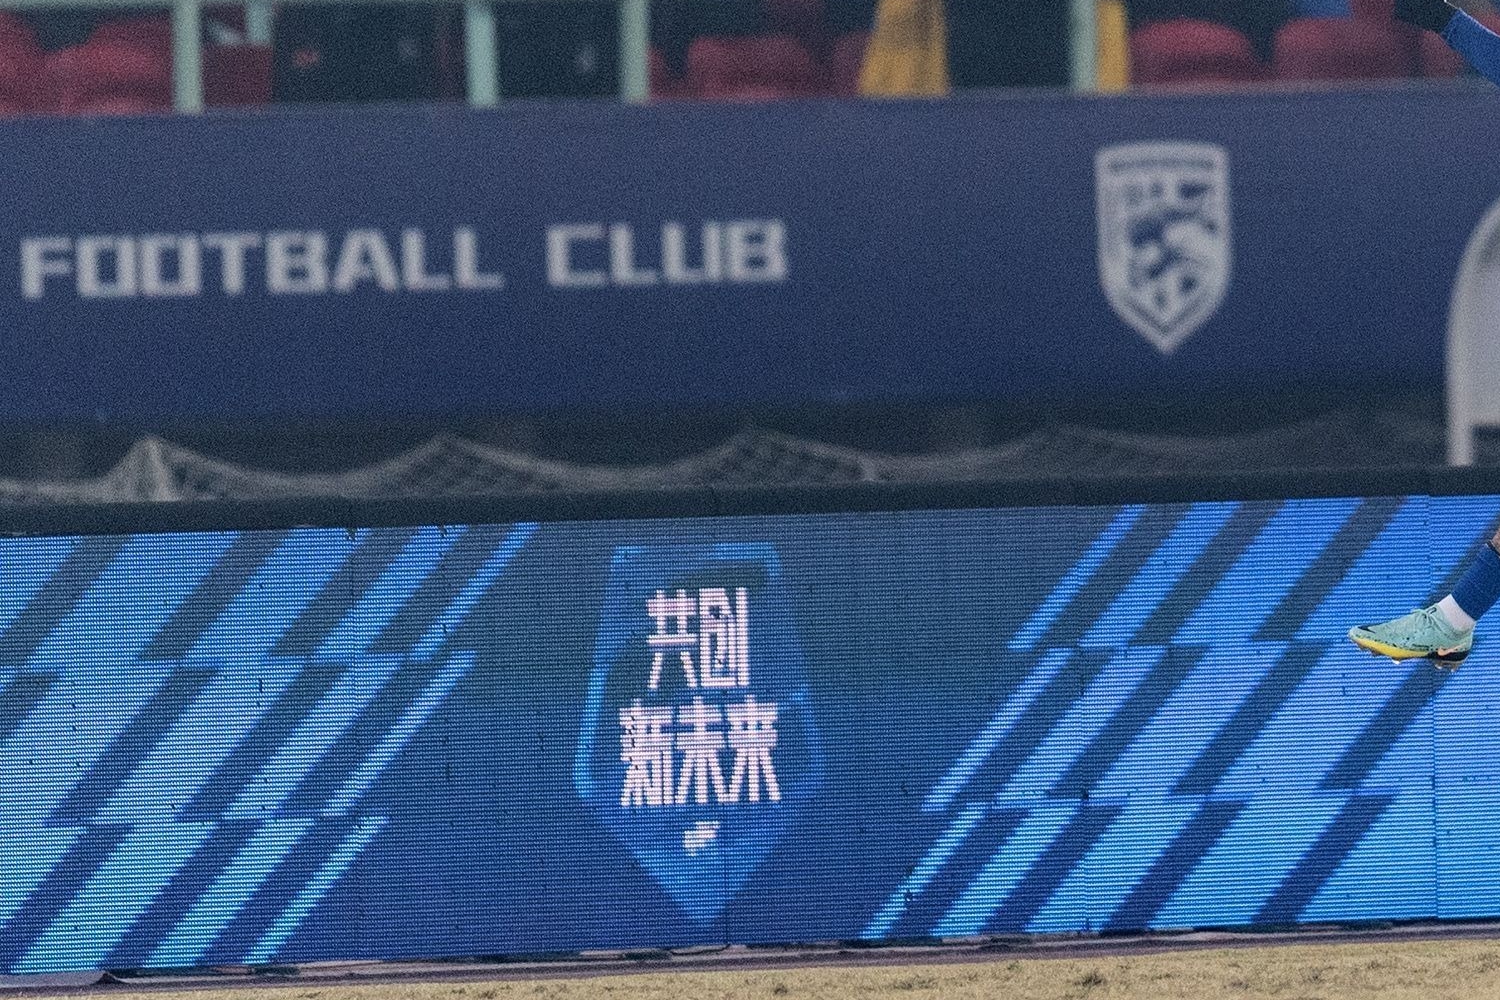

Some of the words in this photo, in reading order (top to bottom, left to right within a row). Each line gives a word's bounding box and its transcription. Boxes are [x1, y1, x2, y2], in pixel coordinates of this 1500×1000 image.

[20, 226, 504, 300] FOOTBALL
[544, 218, 788, 287] CLUB
[646, 587, 750, 690] 共创
[618, 696, 782, 807] 新未来
